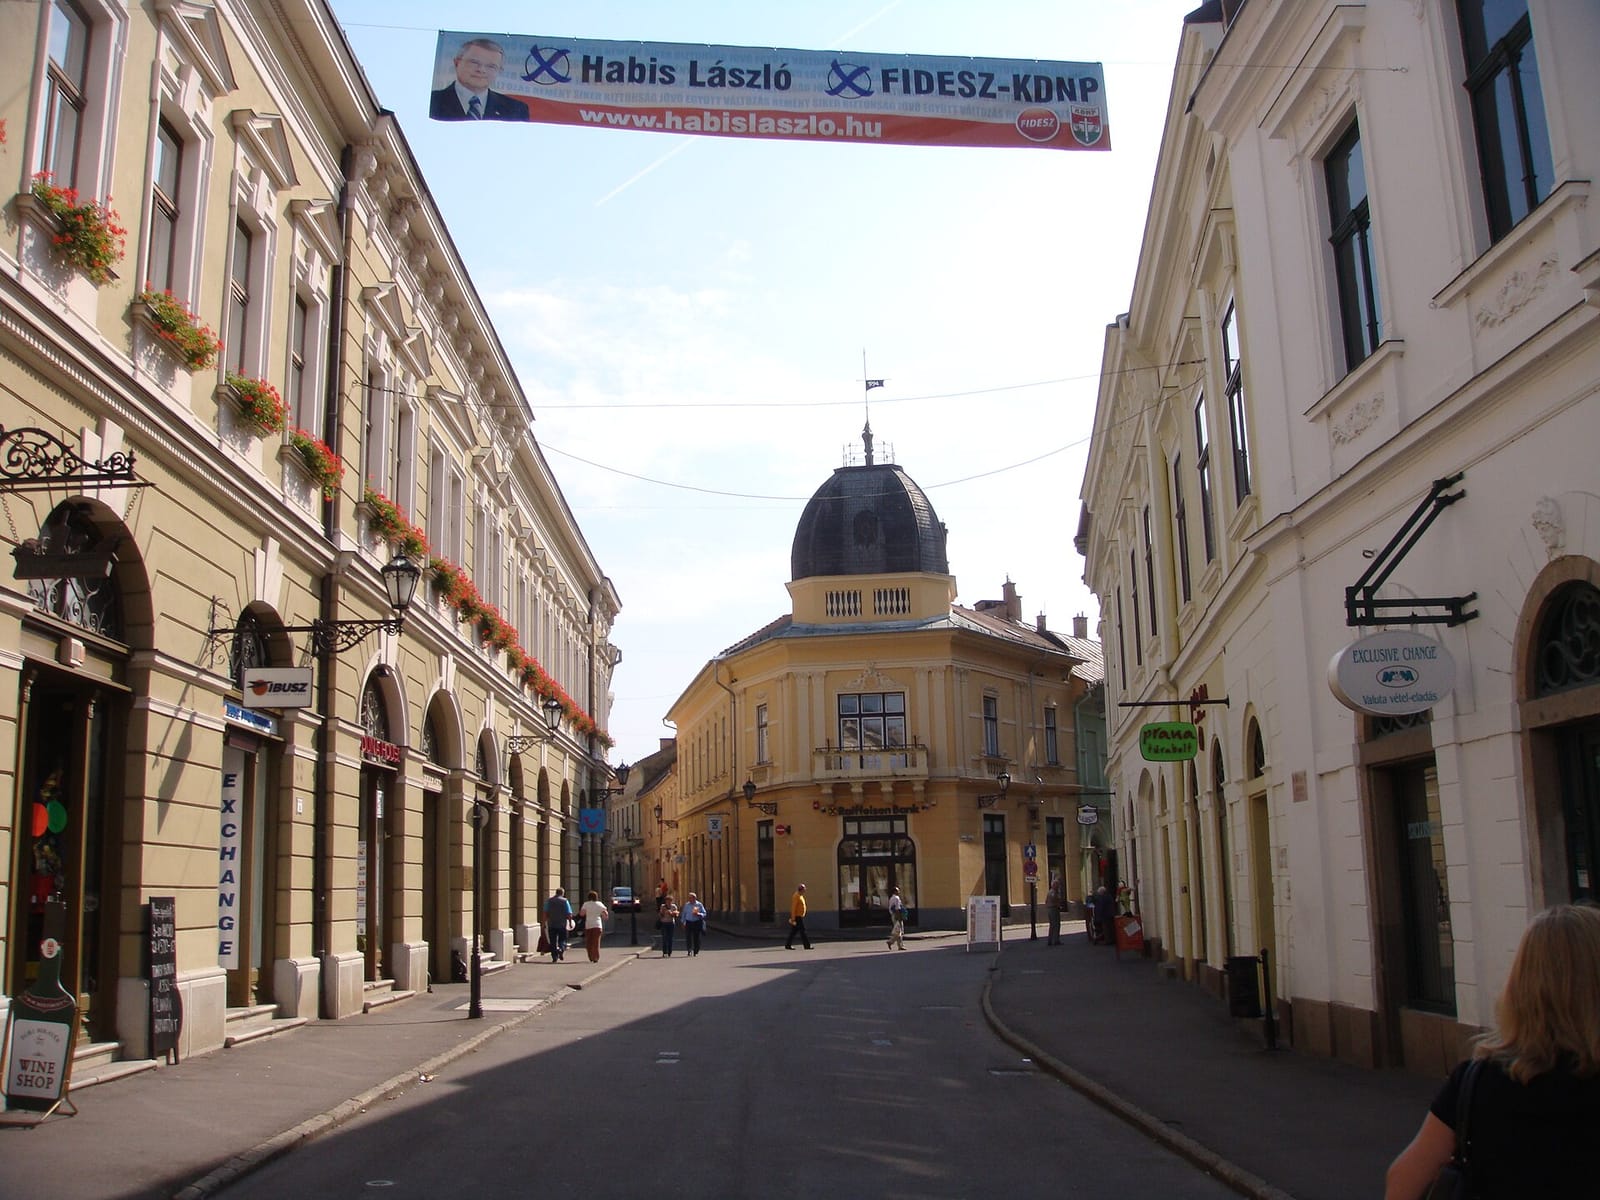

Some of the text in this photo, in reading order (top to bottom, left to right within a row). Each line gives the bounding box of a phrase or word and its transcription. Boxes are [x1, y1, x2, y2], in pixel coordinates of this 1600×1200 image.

[582, 55, 792, 91] Habis László
[881, 68, 1099, 103] FIDESZ-KDNP
[579, 109, 882, 137] www.habislaszlo.hu
[1020, 118, 1055, 129] FIDESZ
[1352, 646, 1438, 664] EXCLUSIVE CHANGE
[268, 682, 308, 693] IBUSZ
[1362, 691, 1438, 705] Valuta vétel-eladás
[1143, 727, 1195, 745] prana
[893, 803, 919, 814] Bank
[217, 773, 238, 956] EXCHANGE
[19, 1057, 56, 1075] WINE
[16, 1072, 54, 1090] SHOP
